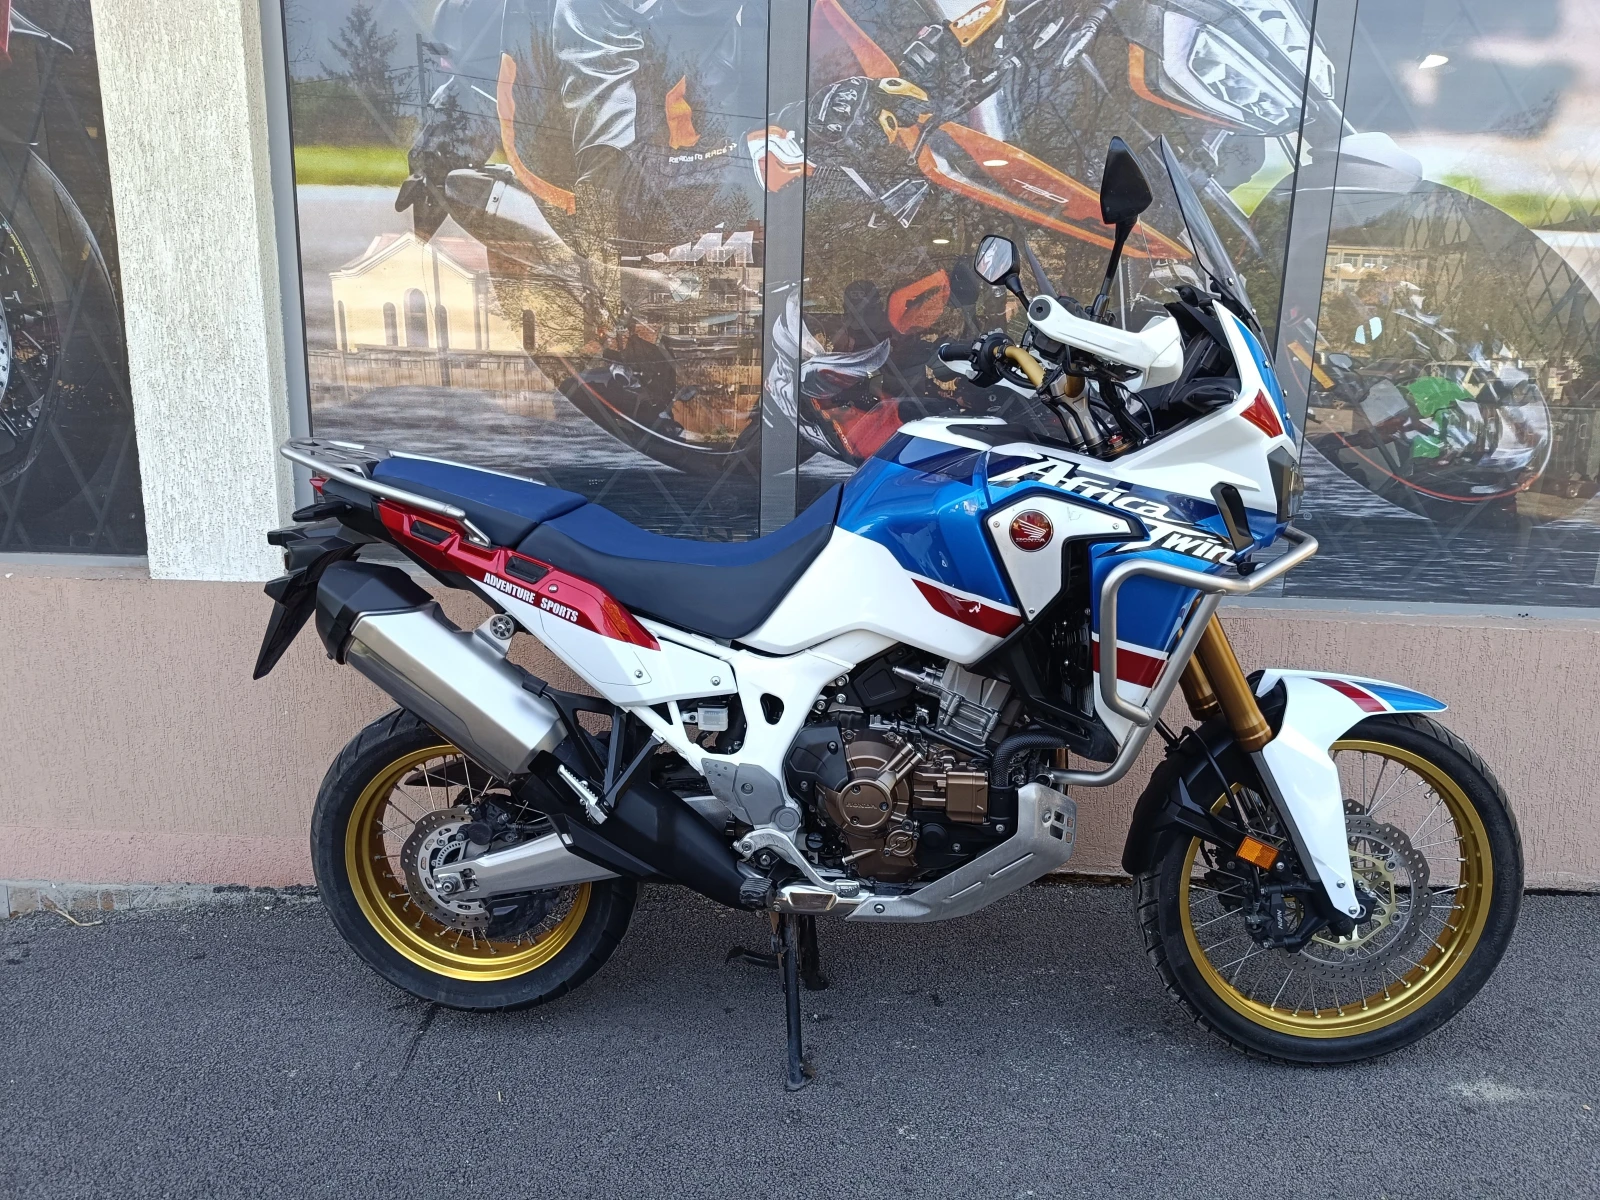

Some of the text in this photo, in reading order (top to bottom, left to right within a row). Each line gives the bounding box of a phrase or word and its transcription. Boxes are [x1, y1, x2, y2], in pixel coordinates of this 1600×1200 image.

[987, 456, 1195, 525] Africa
[1115, 517, 1237, 567] Twin
[483, 572, 579, 622] ADVENTURE SPORTS
